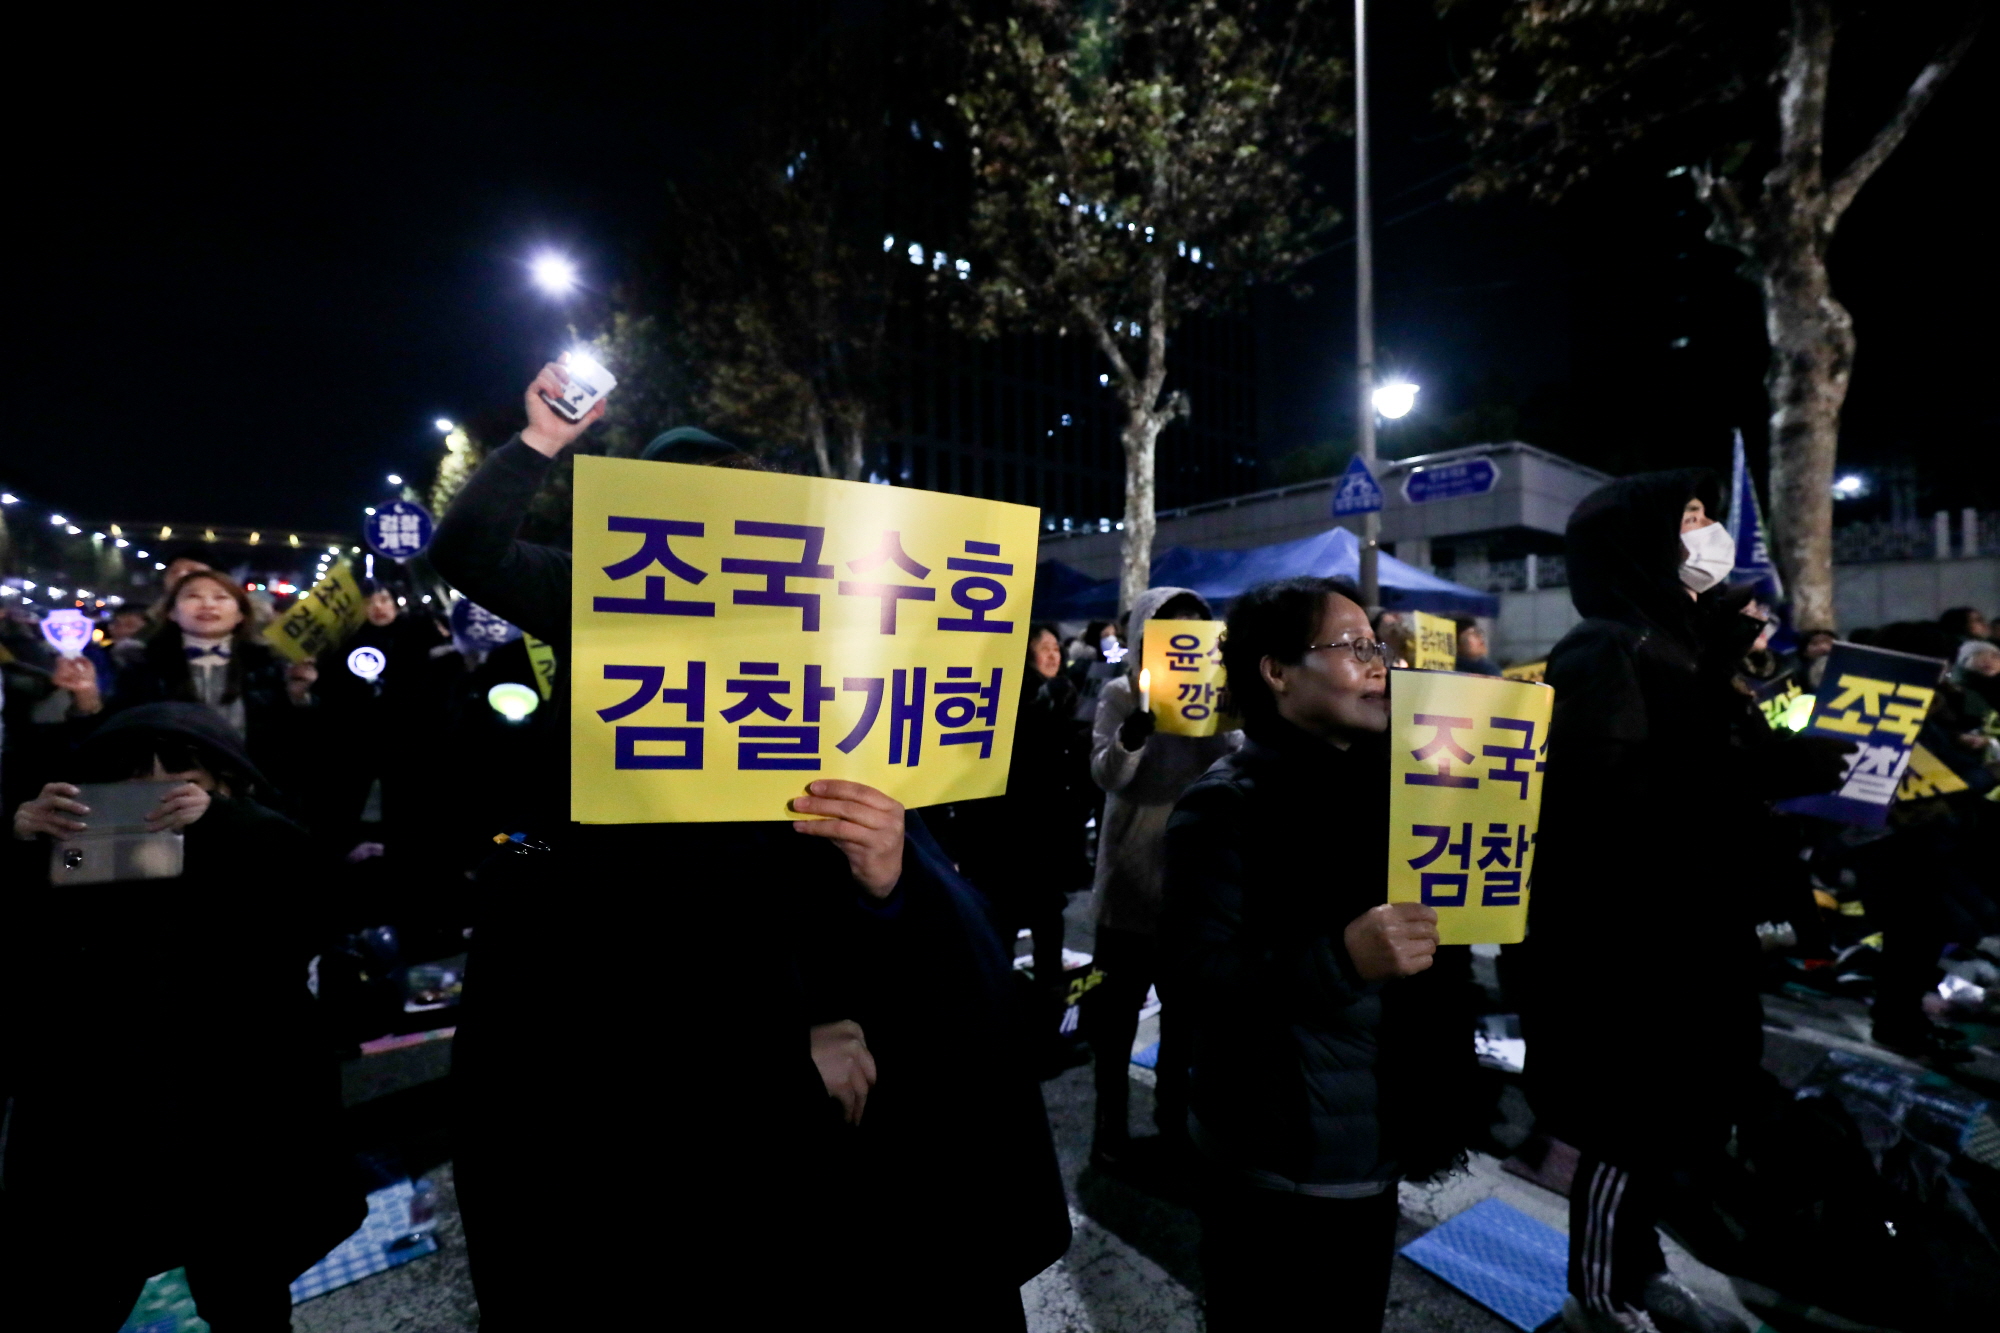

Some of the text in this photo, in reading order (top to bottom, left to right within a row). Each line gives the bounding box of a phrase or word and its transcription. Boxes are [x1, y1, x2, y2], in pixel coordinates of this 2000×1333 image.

[379, 514, 420, 531] 검찰
[379, 532, 420, 549] 개혁
[593, 515, 1014, 635] 조국수호
[596, 661, 1004, 771] 검찰개혁
[1405, 713, 1551, 800] 조국
[1407, 823, 1537, 907] 검찰
